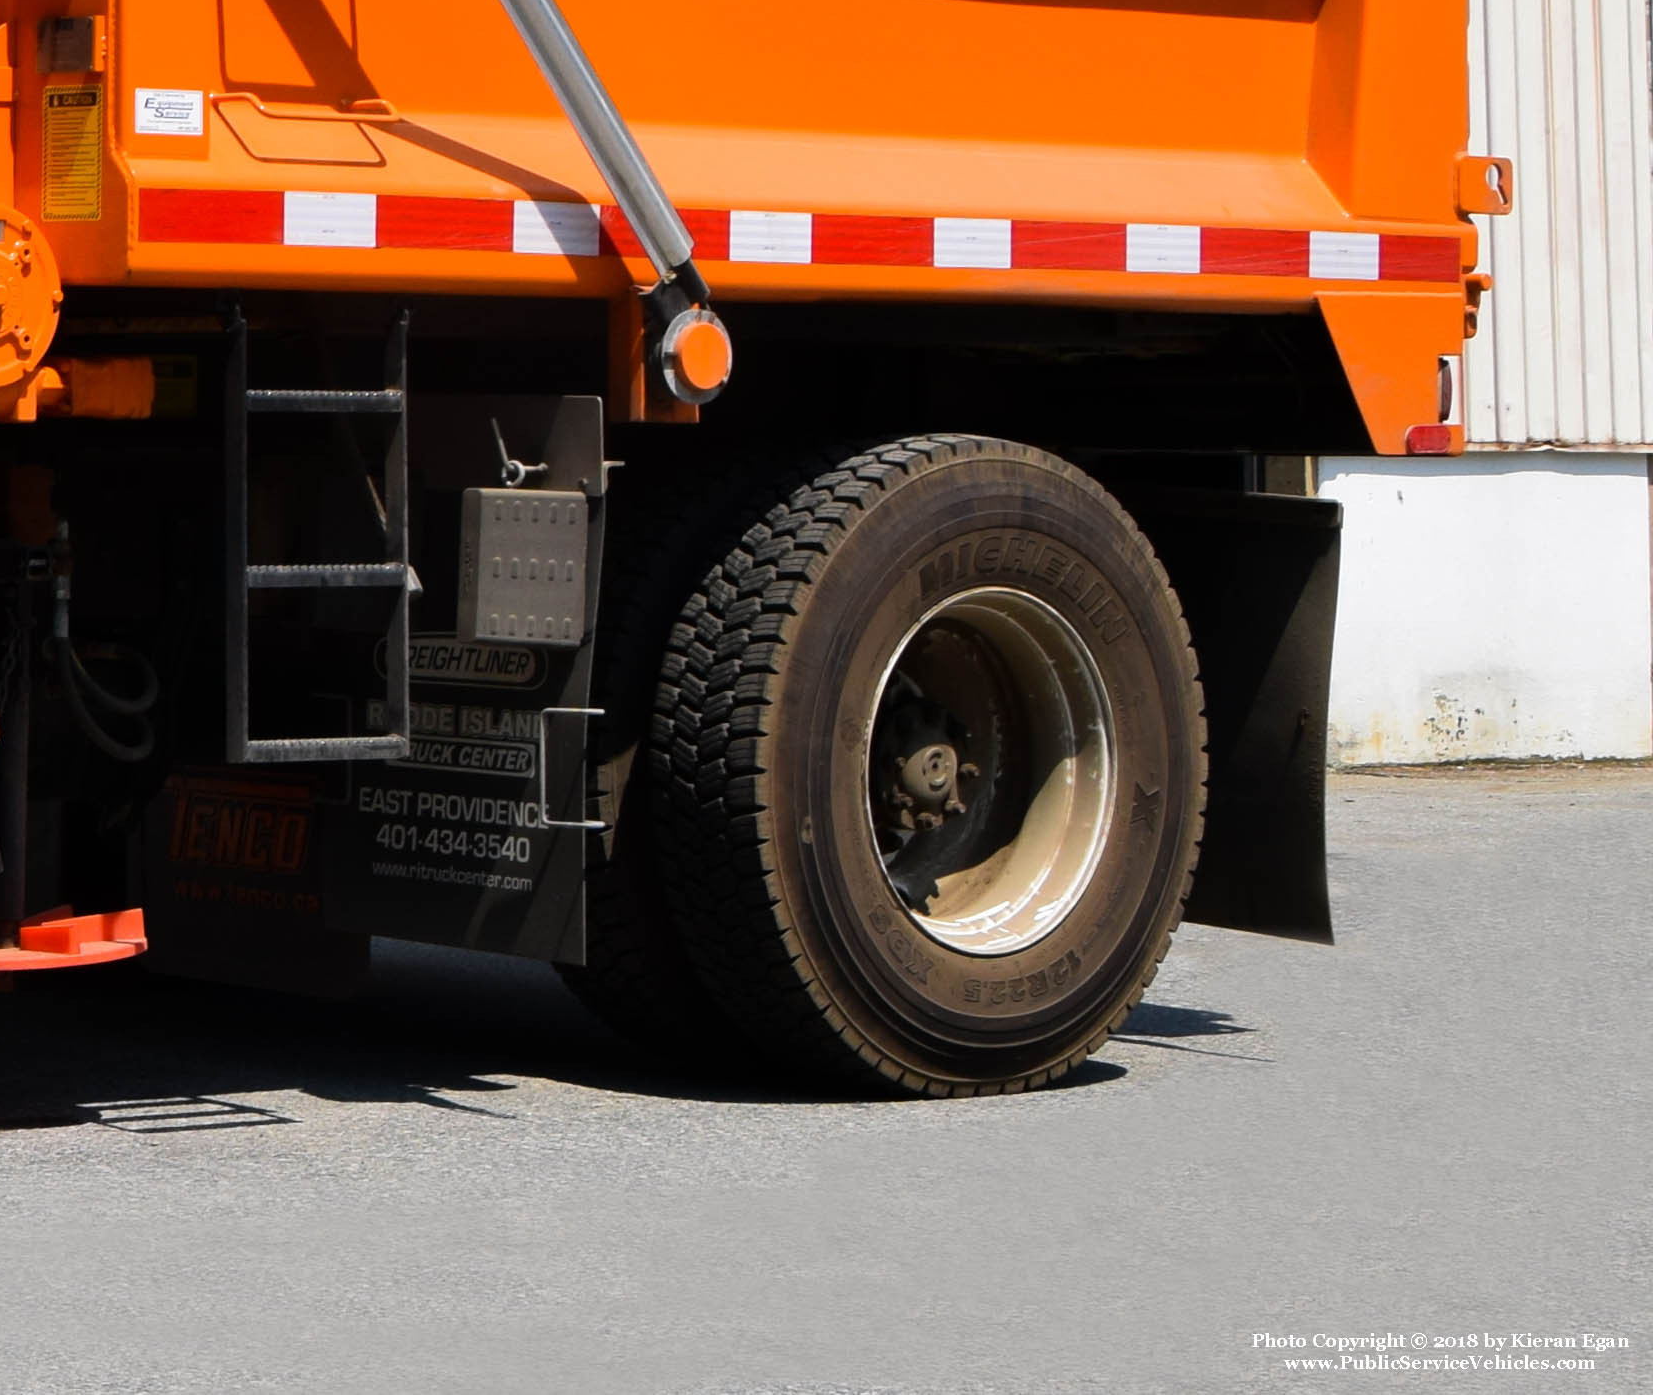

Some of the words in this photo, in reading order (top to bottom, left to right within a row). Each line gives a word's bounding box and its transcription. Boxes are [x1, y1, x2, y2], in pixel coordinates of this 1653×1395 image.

[918, 536, 1130, 646] MICHELIN
[409, 646, 530, 675] REIGHTLINER
[365, 699, 453, 734] RODE
[409, 739, 456, 765] RUCK
[459, 746, 530, 772] CENTER
[164, 774, 311, 872] TENCO
[358, 786, 413, 816] EAST
[416, 792, 549, 830] PROVIDENCE
[372, 862, 533, 892] www.ritruckcenter.com
[964, 954, 1083, 1004] 12R22.5
